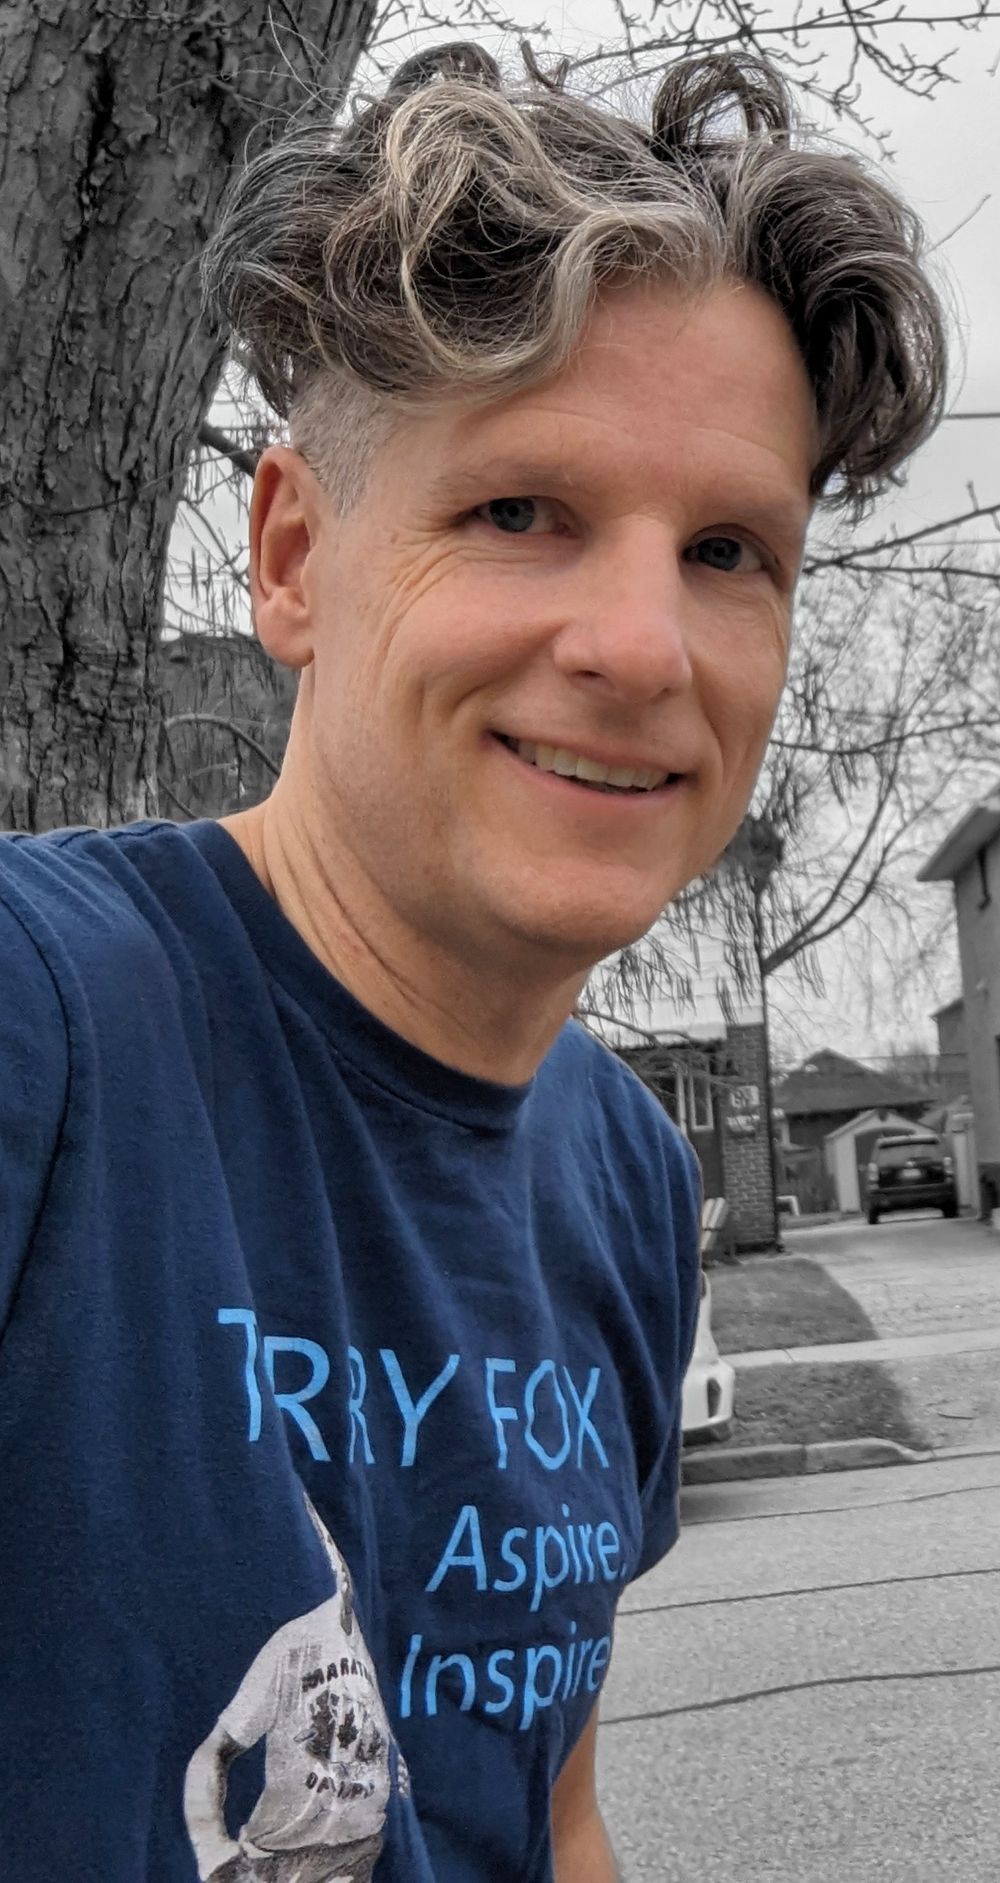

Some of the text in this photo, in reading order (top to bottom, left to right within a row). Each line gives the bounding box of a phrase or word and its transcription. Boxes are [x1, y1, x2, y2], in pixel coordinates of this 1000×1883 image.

[217, 1308, 610, 1471] TRRY FOX
[400, 1621, 611, 1730] Inspire
